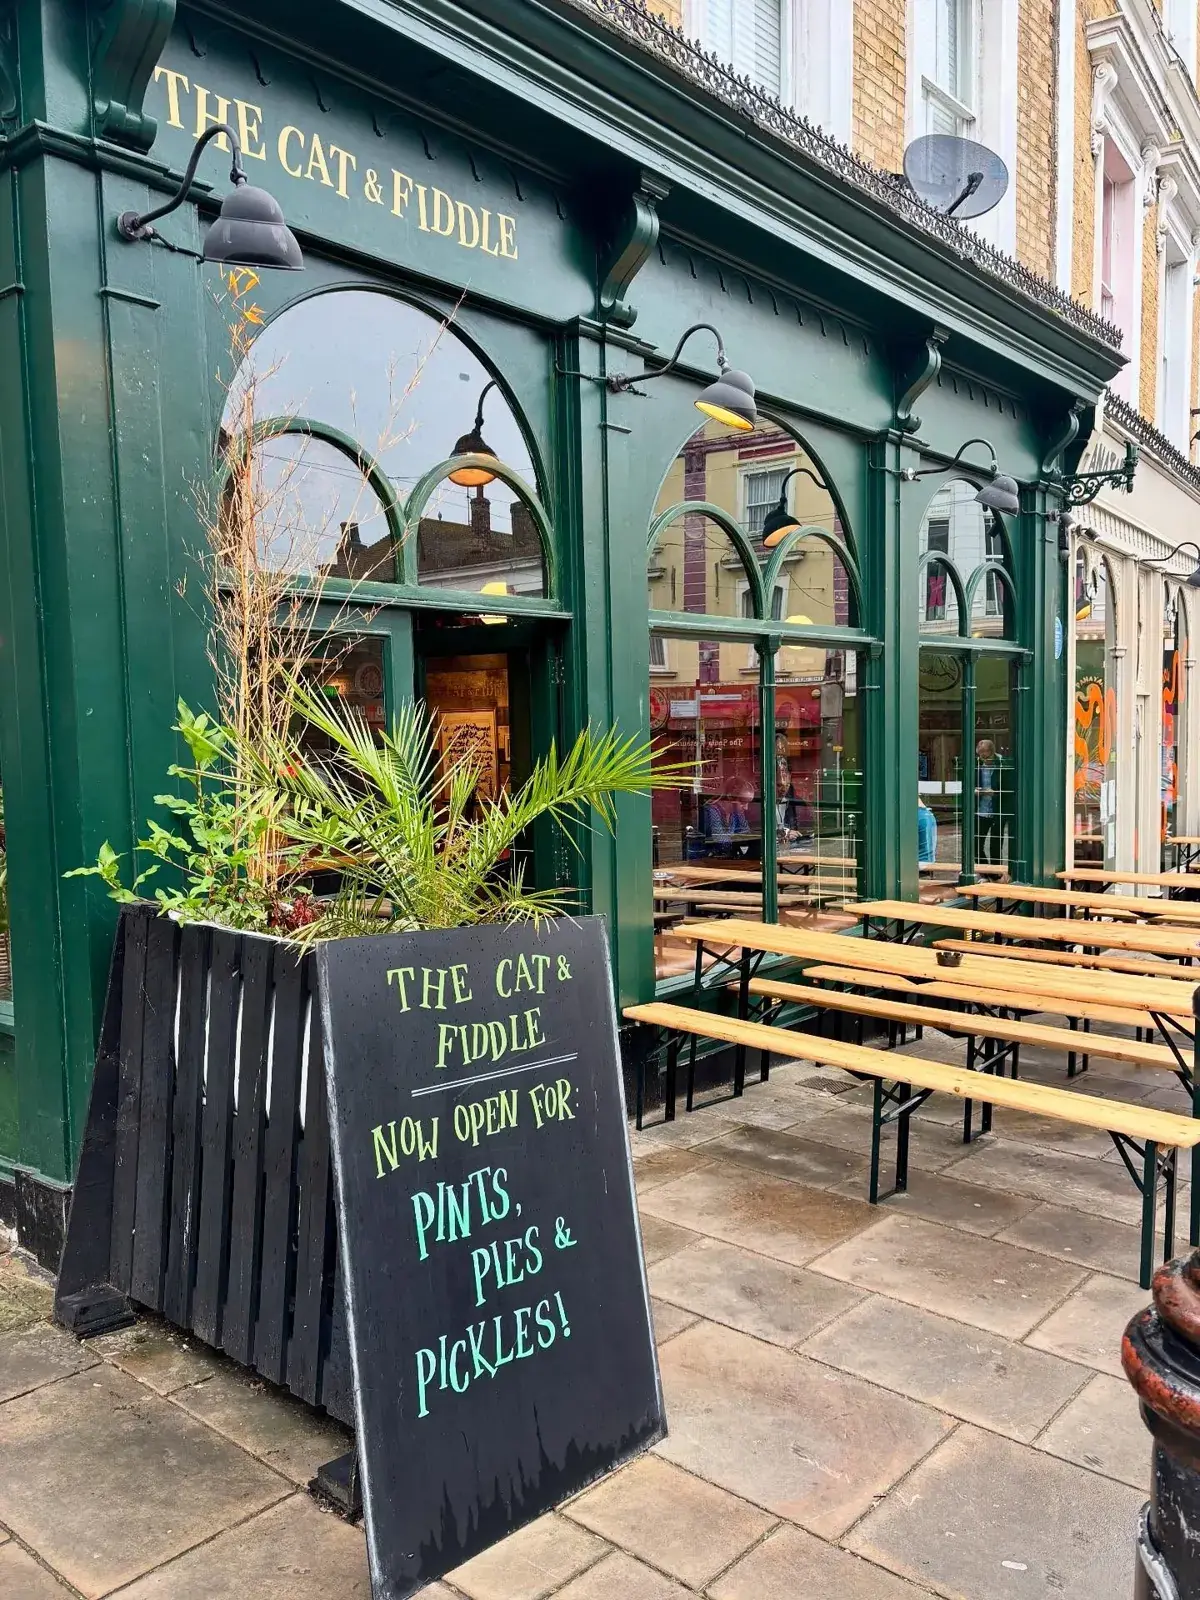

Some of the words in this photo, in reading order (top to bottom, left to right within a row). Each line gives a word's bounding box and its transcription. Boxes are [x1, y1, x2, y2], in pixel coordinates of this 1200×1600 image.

[154, 66, 267, 161] THE
[278, 125, 356, 199] CAT
[365, 168, 384, 205] &
[391, 168, 518, 260] FIDDLE
[387, 965, 473, 1014] THE
[496, 953, 551, 998] CAT
[557, 954, 573, 982] &
[434, 1007, 546, 1069] FIDDLE
[371, 1115, 440, 1179] NOW
[453, 1089, 518, 1147] OPEN
[528, 1078, 579, 1129] FOR:
[411, 1166, 522, 1261] PINTS,
[470, 1226, 543, 1308] PIES
[554, 1216, 578, 1249] &
[414, 1290, 572, 1419] PICKLES!
